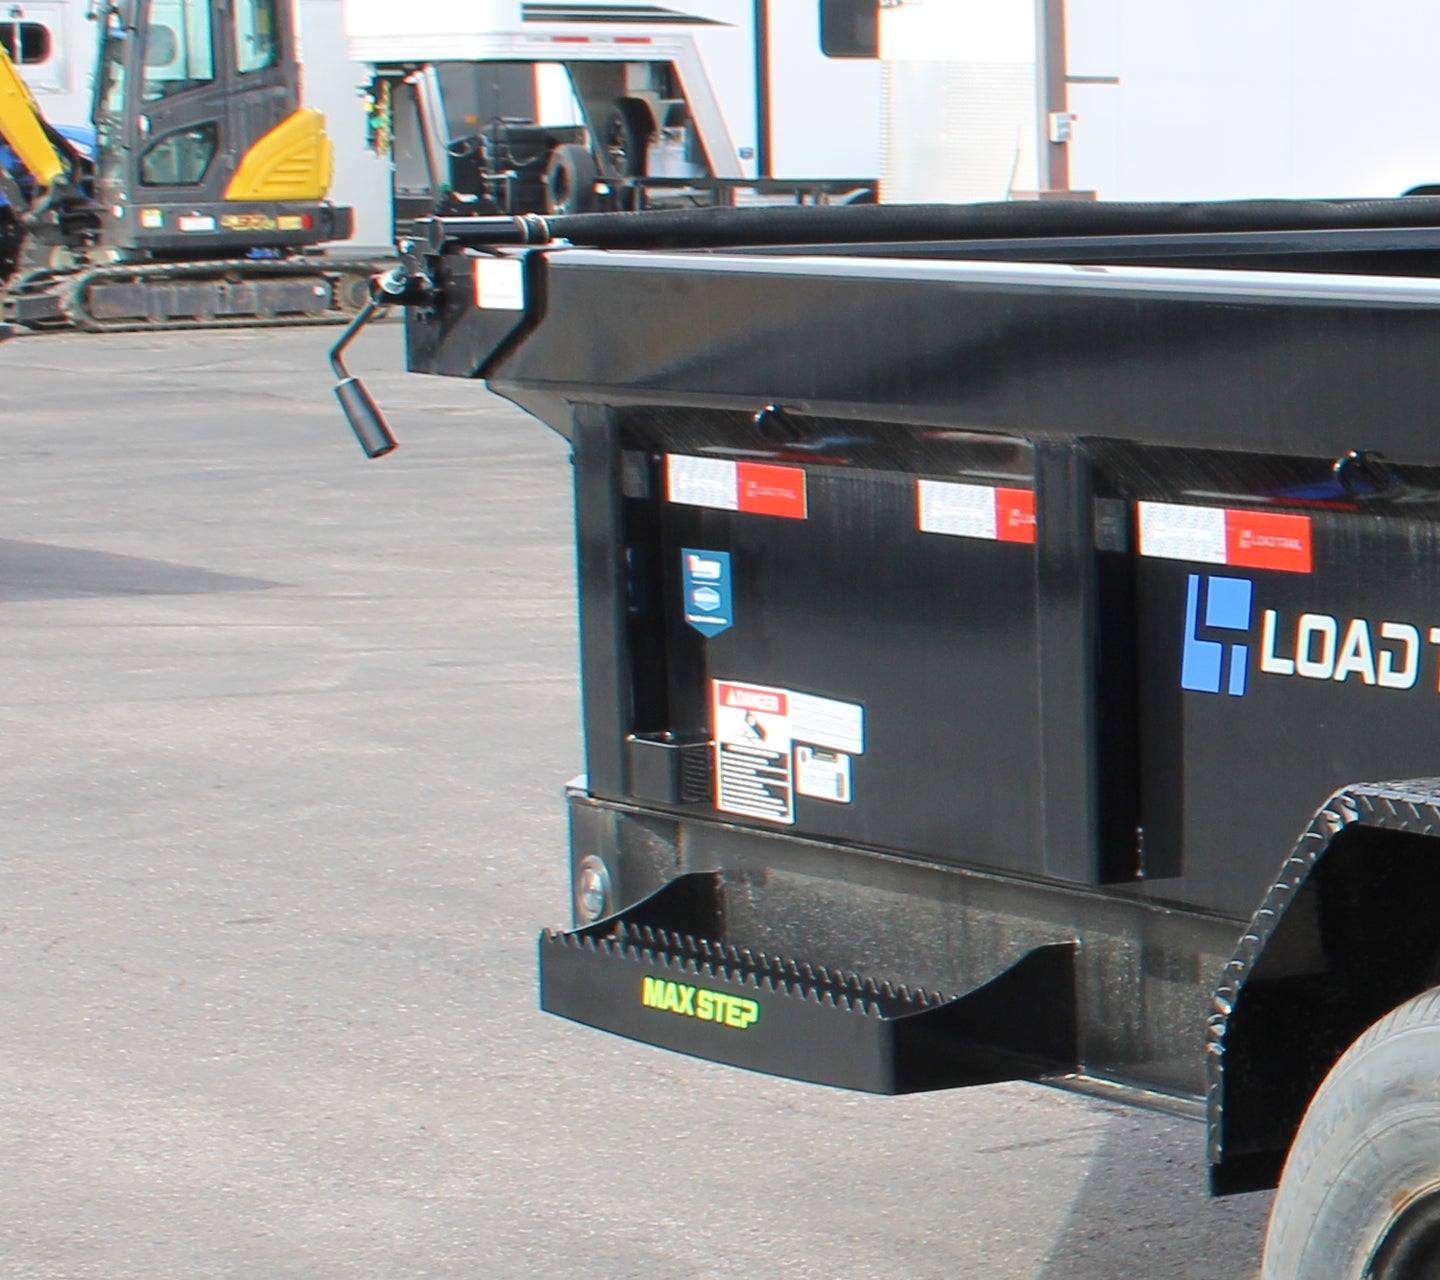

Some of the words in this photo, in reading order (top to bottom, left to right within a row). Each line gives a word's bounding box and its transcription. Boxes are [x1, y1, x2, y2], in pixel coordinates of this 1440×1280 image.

[1260, 608, 1422, 690] LOAD
[736, 690, 780, 713] DANGER
[642, 976, 696, 1017] MAX
[695, 988, 760, 1030] STEP
